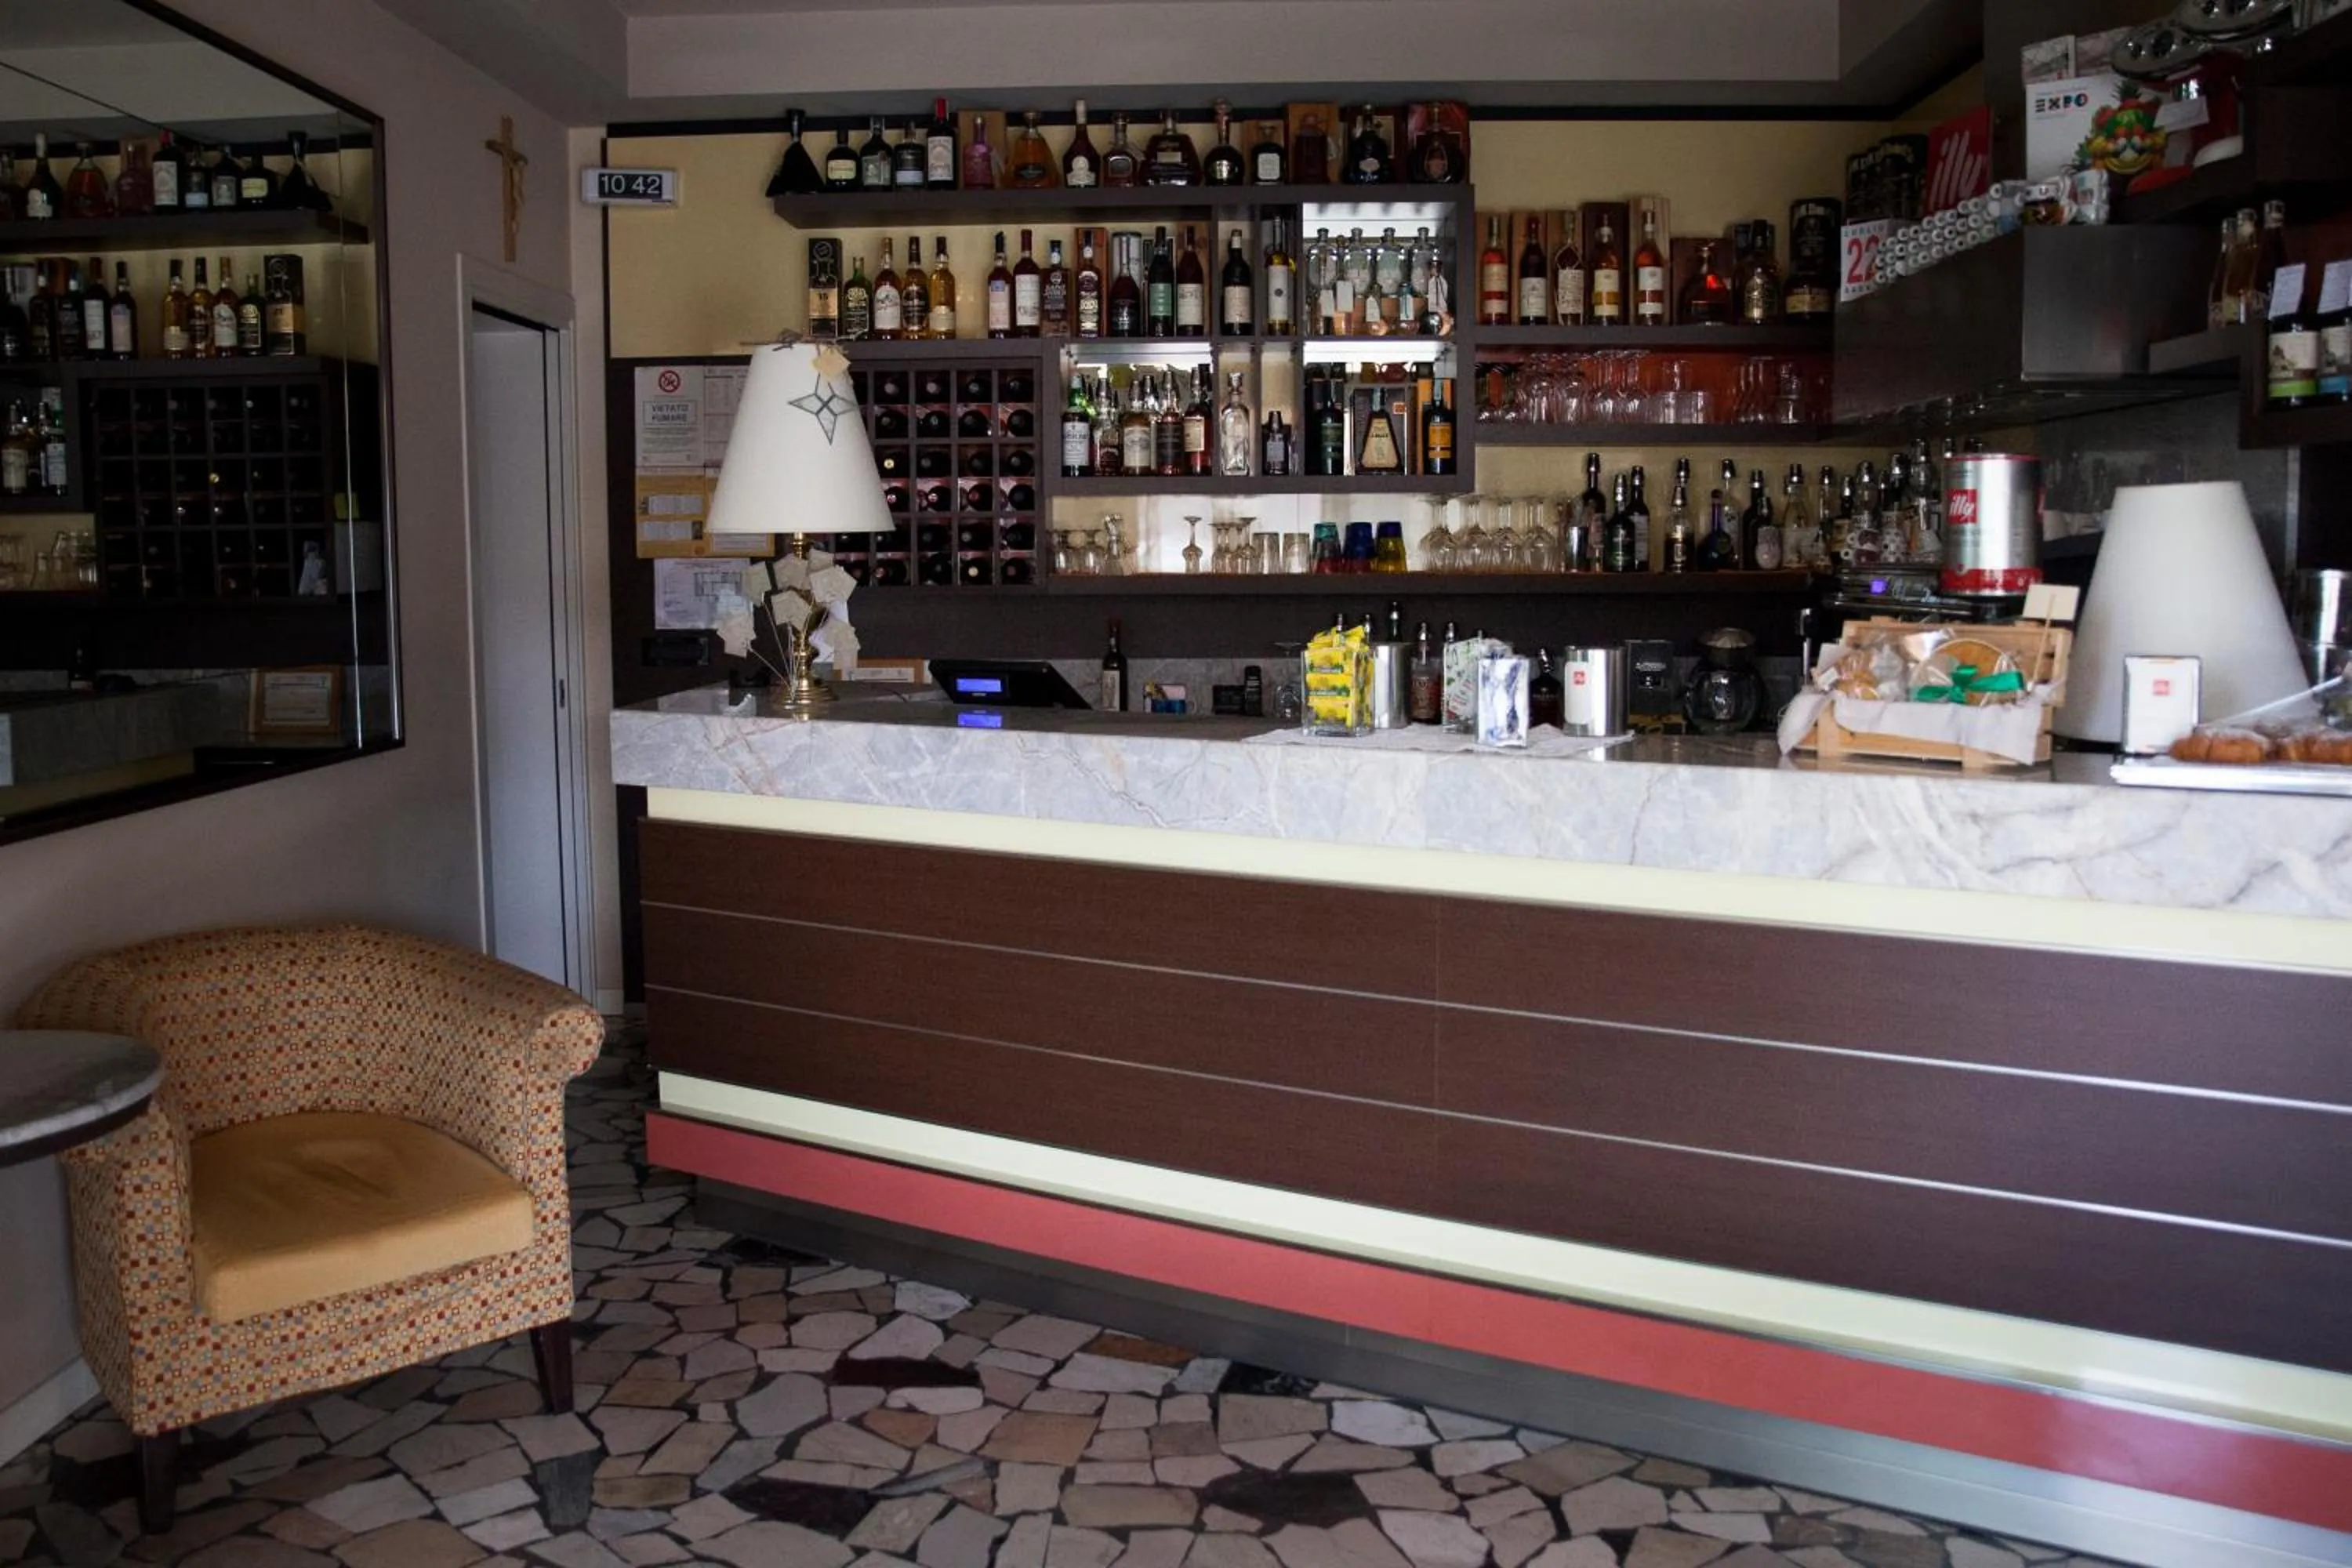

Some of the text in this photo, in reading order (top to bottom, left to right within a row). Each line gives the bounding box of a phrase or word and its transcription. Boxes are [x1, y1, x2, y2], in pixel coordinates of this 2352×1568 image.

[2034, 93, 2089, 113] EXPO
[601, 174, 661, 194] 10 42
[1847, 234, 1879, 283] 22
[652, 403, 689, 412] VIETATO
[1949, 494, 1975, 521] illy
